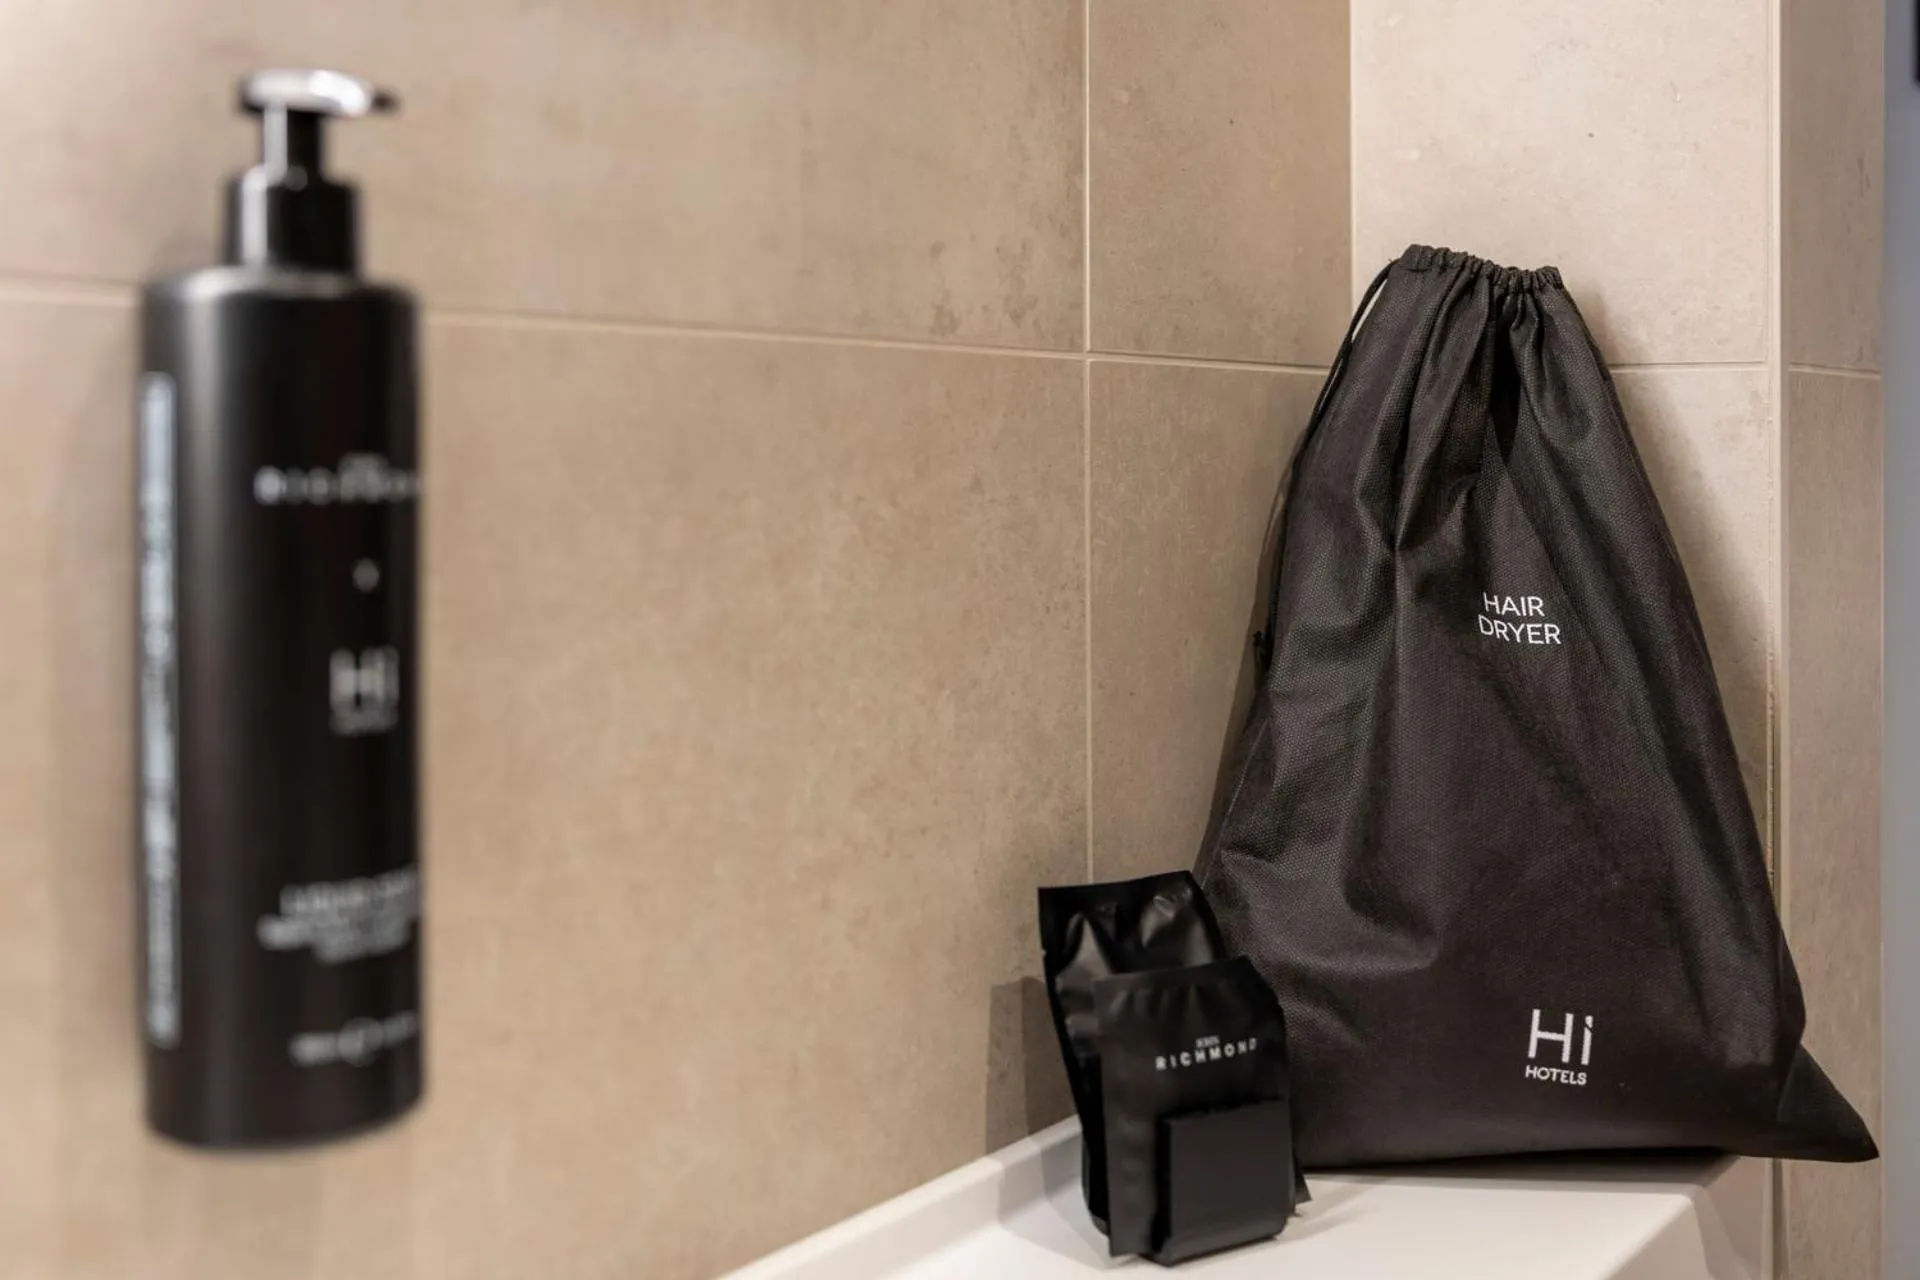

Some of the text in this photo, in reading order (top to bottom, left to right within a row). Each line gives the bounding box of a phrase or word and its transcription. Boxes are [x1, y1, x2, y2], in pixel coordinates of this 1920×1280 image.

[1483, 592, 1545, 616] HAIR
[1478, 614, 1561, 644] DRYER
[1528, 1008, 1594, 1066] Hi
[1525, 1064, 1588, 1086] HOTELS
